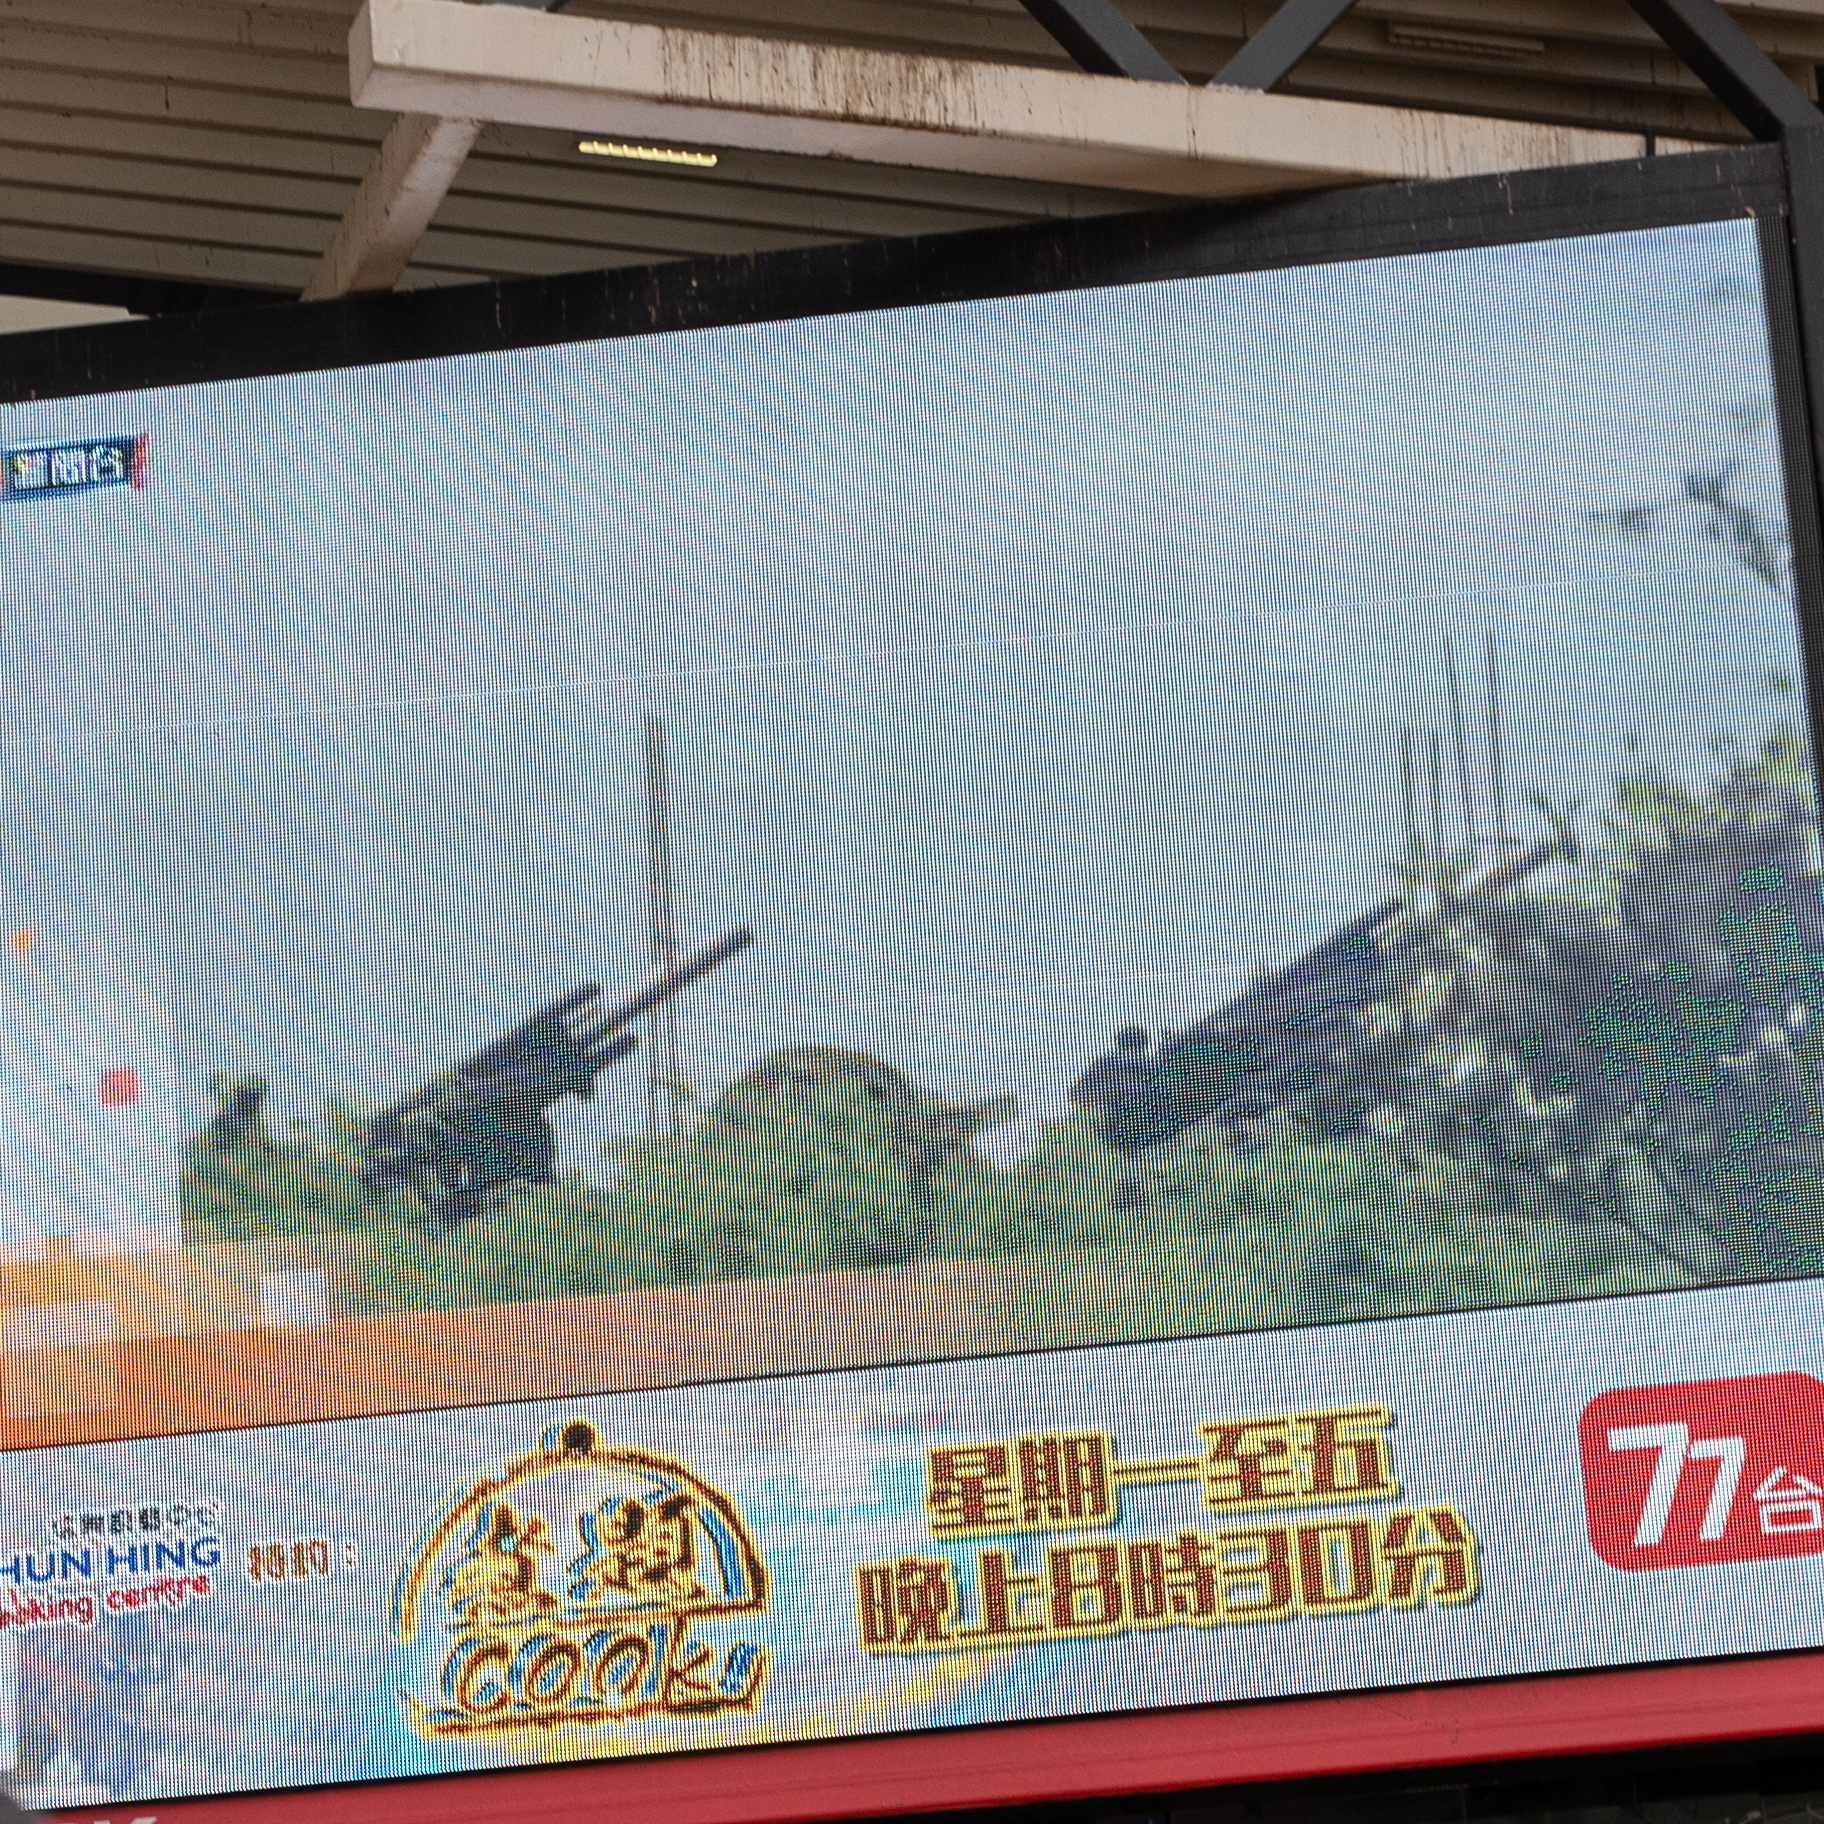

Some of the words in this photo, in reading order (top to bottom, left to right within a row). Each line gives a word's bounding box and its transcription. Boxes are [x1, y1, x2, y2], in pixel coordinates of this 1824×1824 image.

[928, 1400, 1400, 1538] 星期一至五
[108, 1536, 220, 1576] HING
[856, 1506, 1482, 1652] 晚上8時30分
